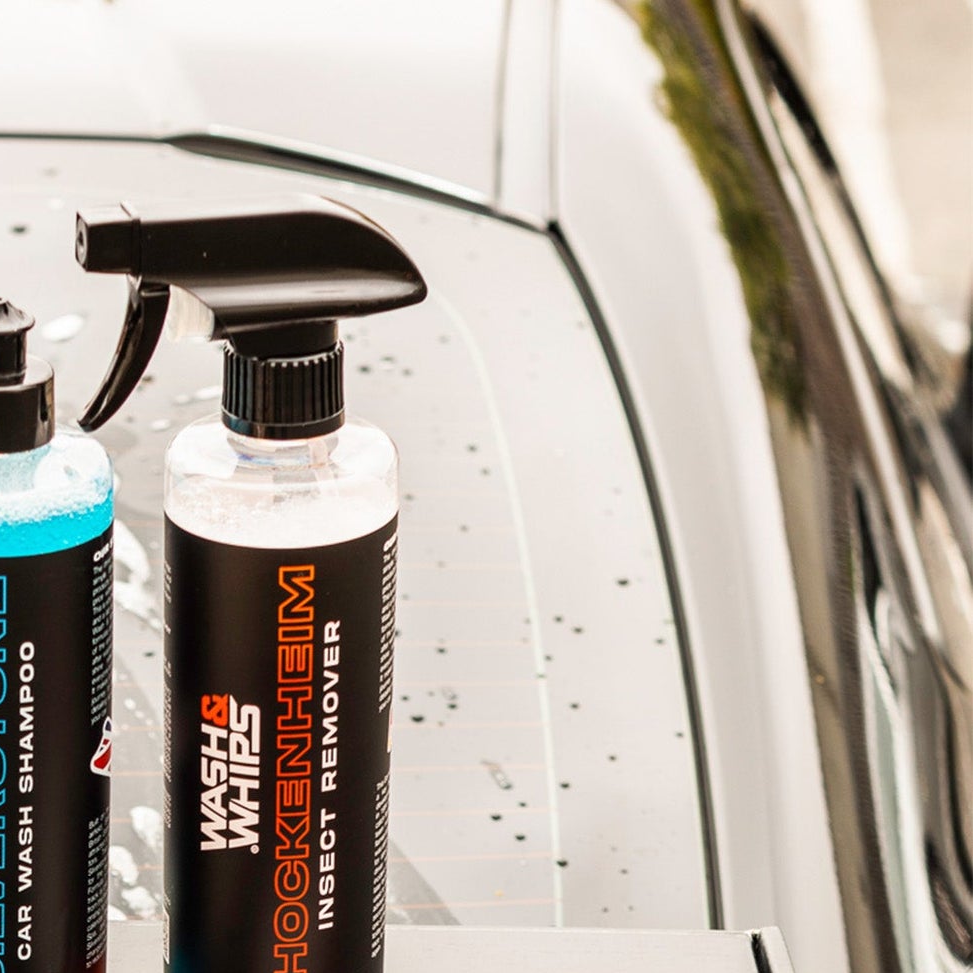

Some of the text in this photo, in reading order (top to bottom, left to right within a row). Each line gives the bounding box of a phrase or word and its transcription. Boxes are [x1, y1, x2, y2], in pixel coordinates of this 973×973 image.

[17, 640, 35, 961] CAR WASH SHAMPOO
[229, 694, 261, 846] WHIPS
[317, 620, 341, 931] INSECT REMOVER
